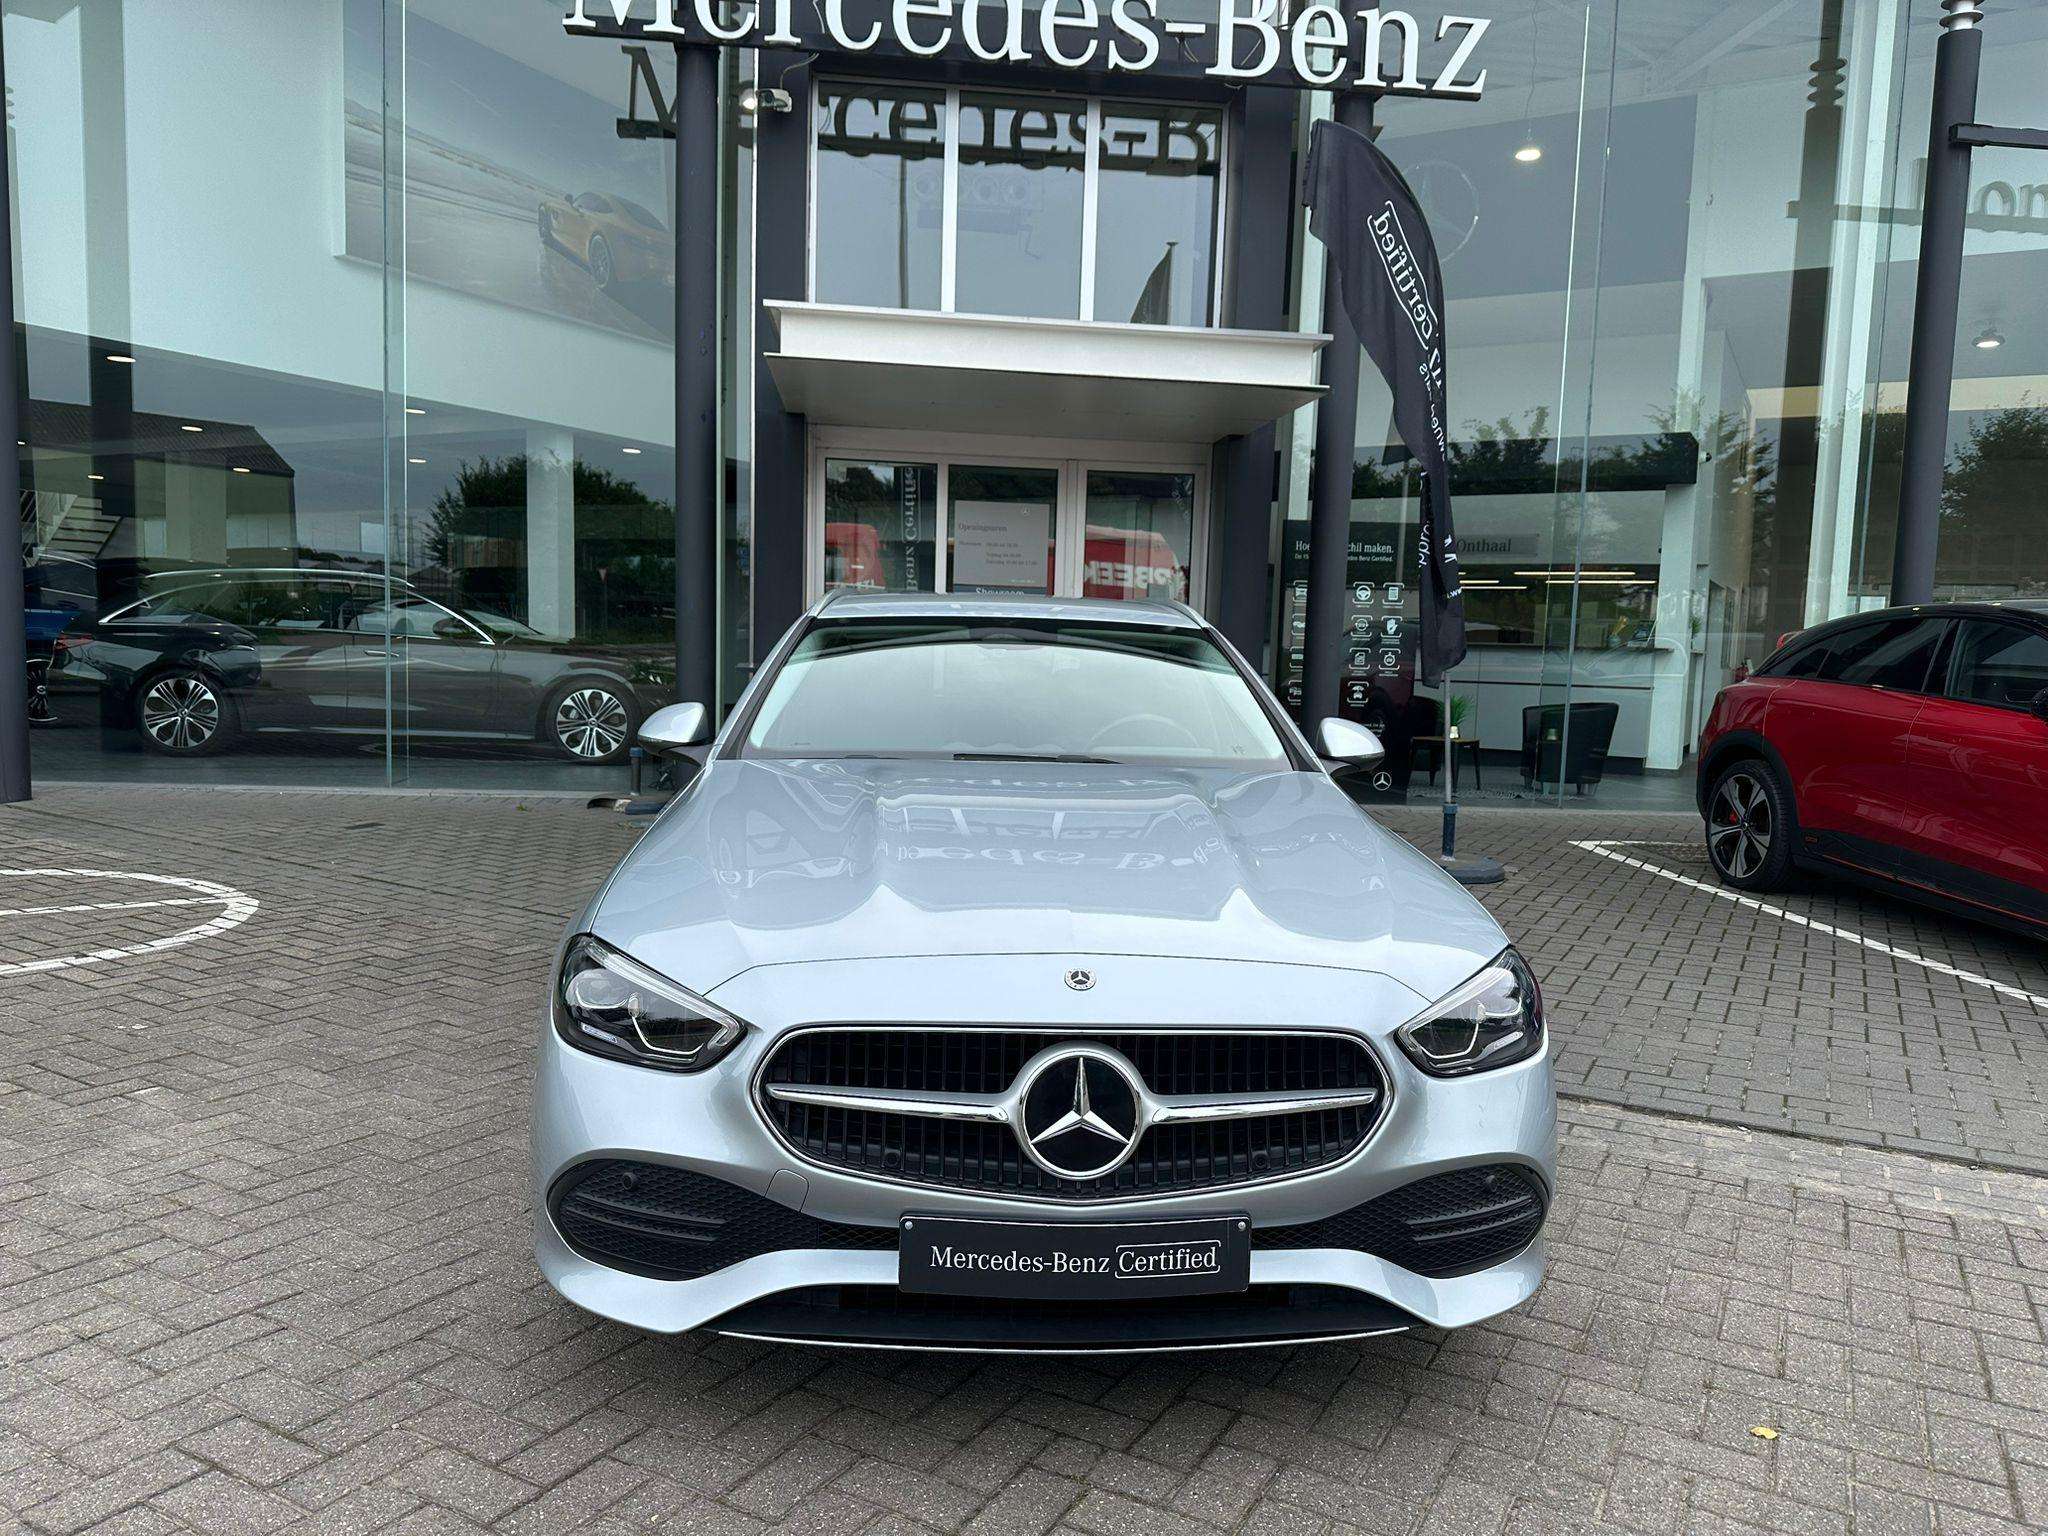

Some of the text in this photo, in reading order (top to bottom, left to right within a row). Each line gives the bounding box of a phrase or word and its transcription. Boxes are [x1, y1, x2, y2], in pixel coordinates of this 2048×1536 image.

[1364, 543, 1394, 554] maken.
[1456, 538, 1512, 553] Onthaal
[929, 1245, 1218, 1274] Mercedes-Benz Certified
